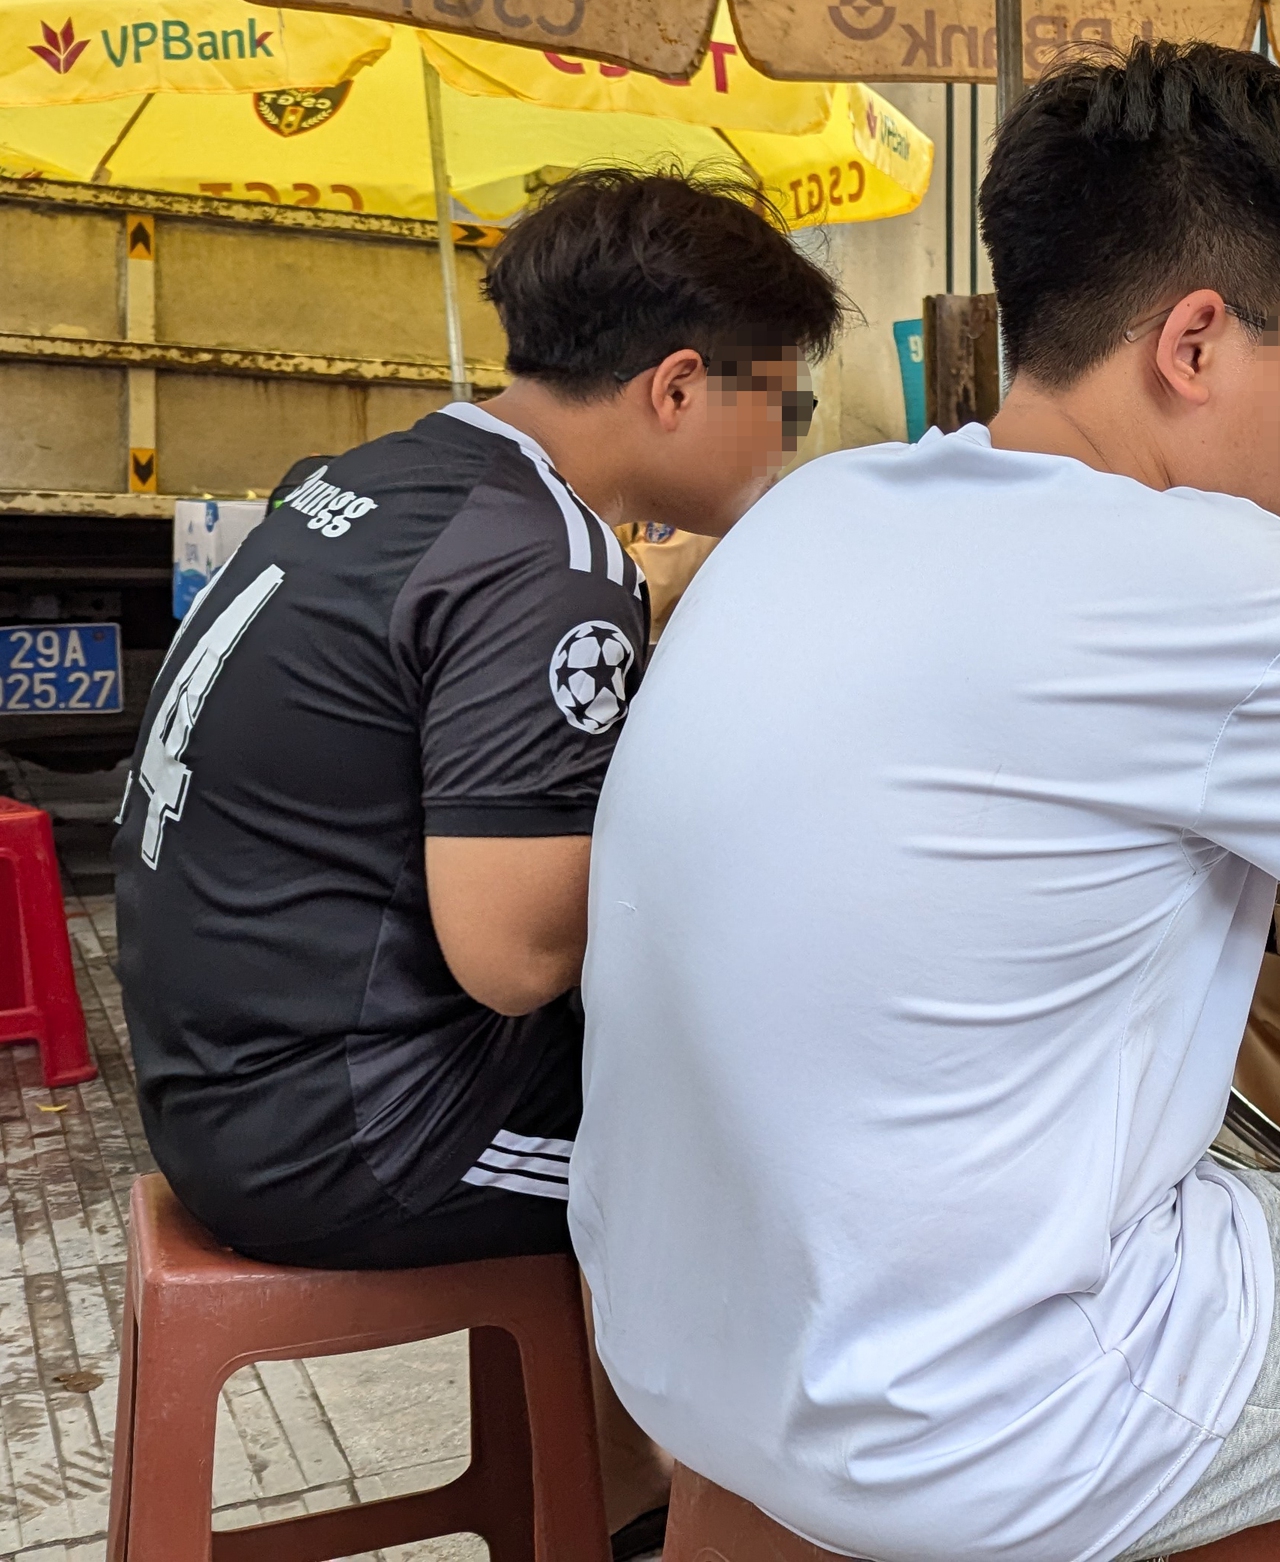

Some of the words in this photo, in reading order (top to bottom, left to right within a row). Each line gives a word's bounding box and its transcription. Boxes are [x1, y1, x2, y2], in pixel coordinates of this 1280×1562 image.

[101, 18, 275, 68] VPBank
[9, 630, 86, 669] 29A
[0, 670, 116, 710] 25.27
[114, 545, 285, 872] 4
